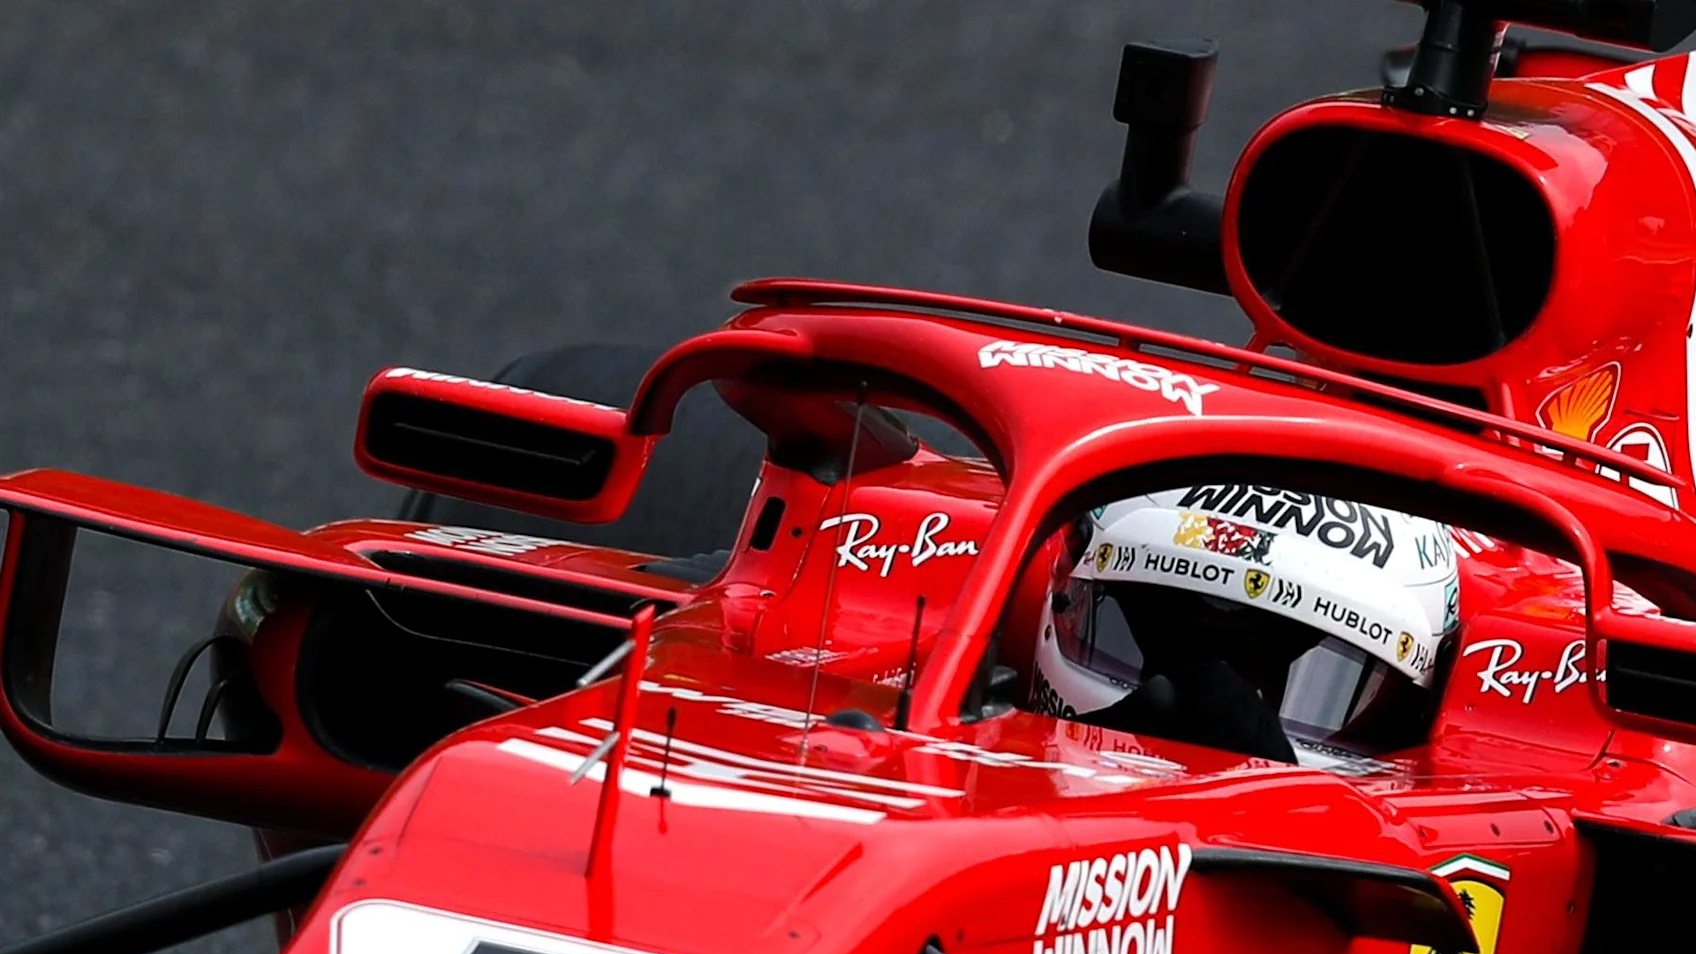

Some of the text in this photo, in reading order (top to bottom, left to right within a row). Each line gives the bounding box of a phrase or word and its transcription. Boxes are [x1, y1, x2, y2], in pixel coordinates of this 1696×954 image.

[978, 350, 1202, 416] WINNOW
[819, 512, 979, 578] Ray-Ban
[1177, 484, 1395, 569] WINNOW
[1144, 553, 1235, 585] HUBLOT
[1313, 596, 1393, 645] HUBLOT
[1035, 843, 1192, 936] MISSION
